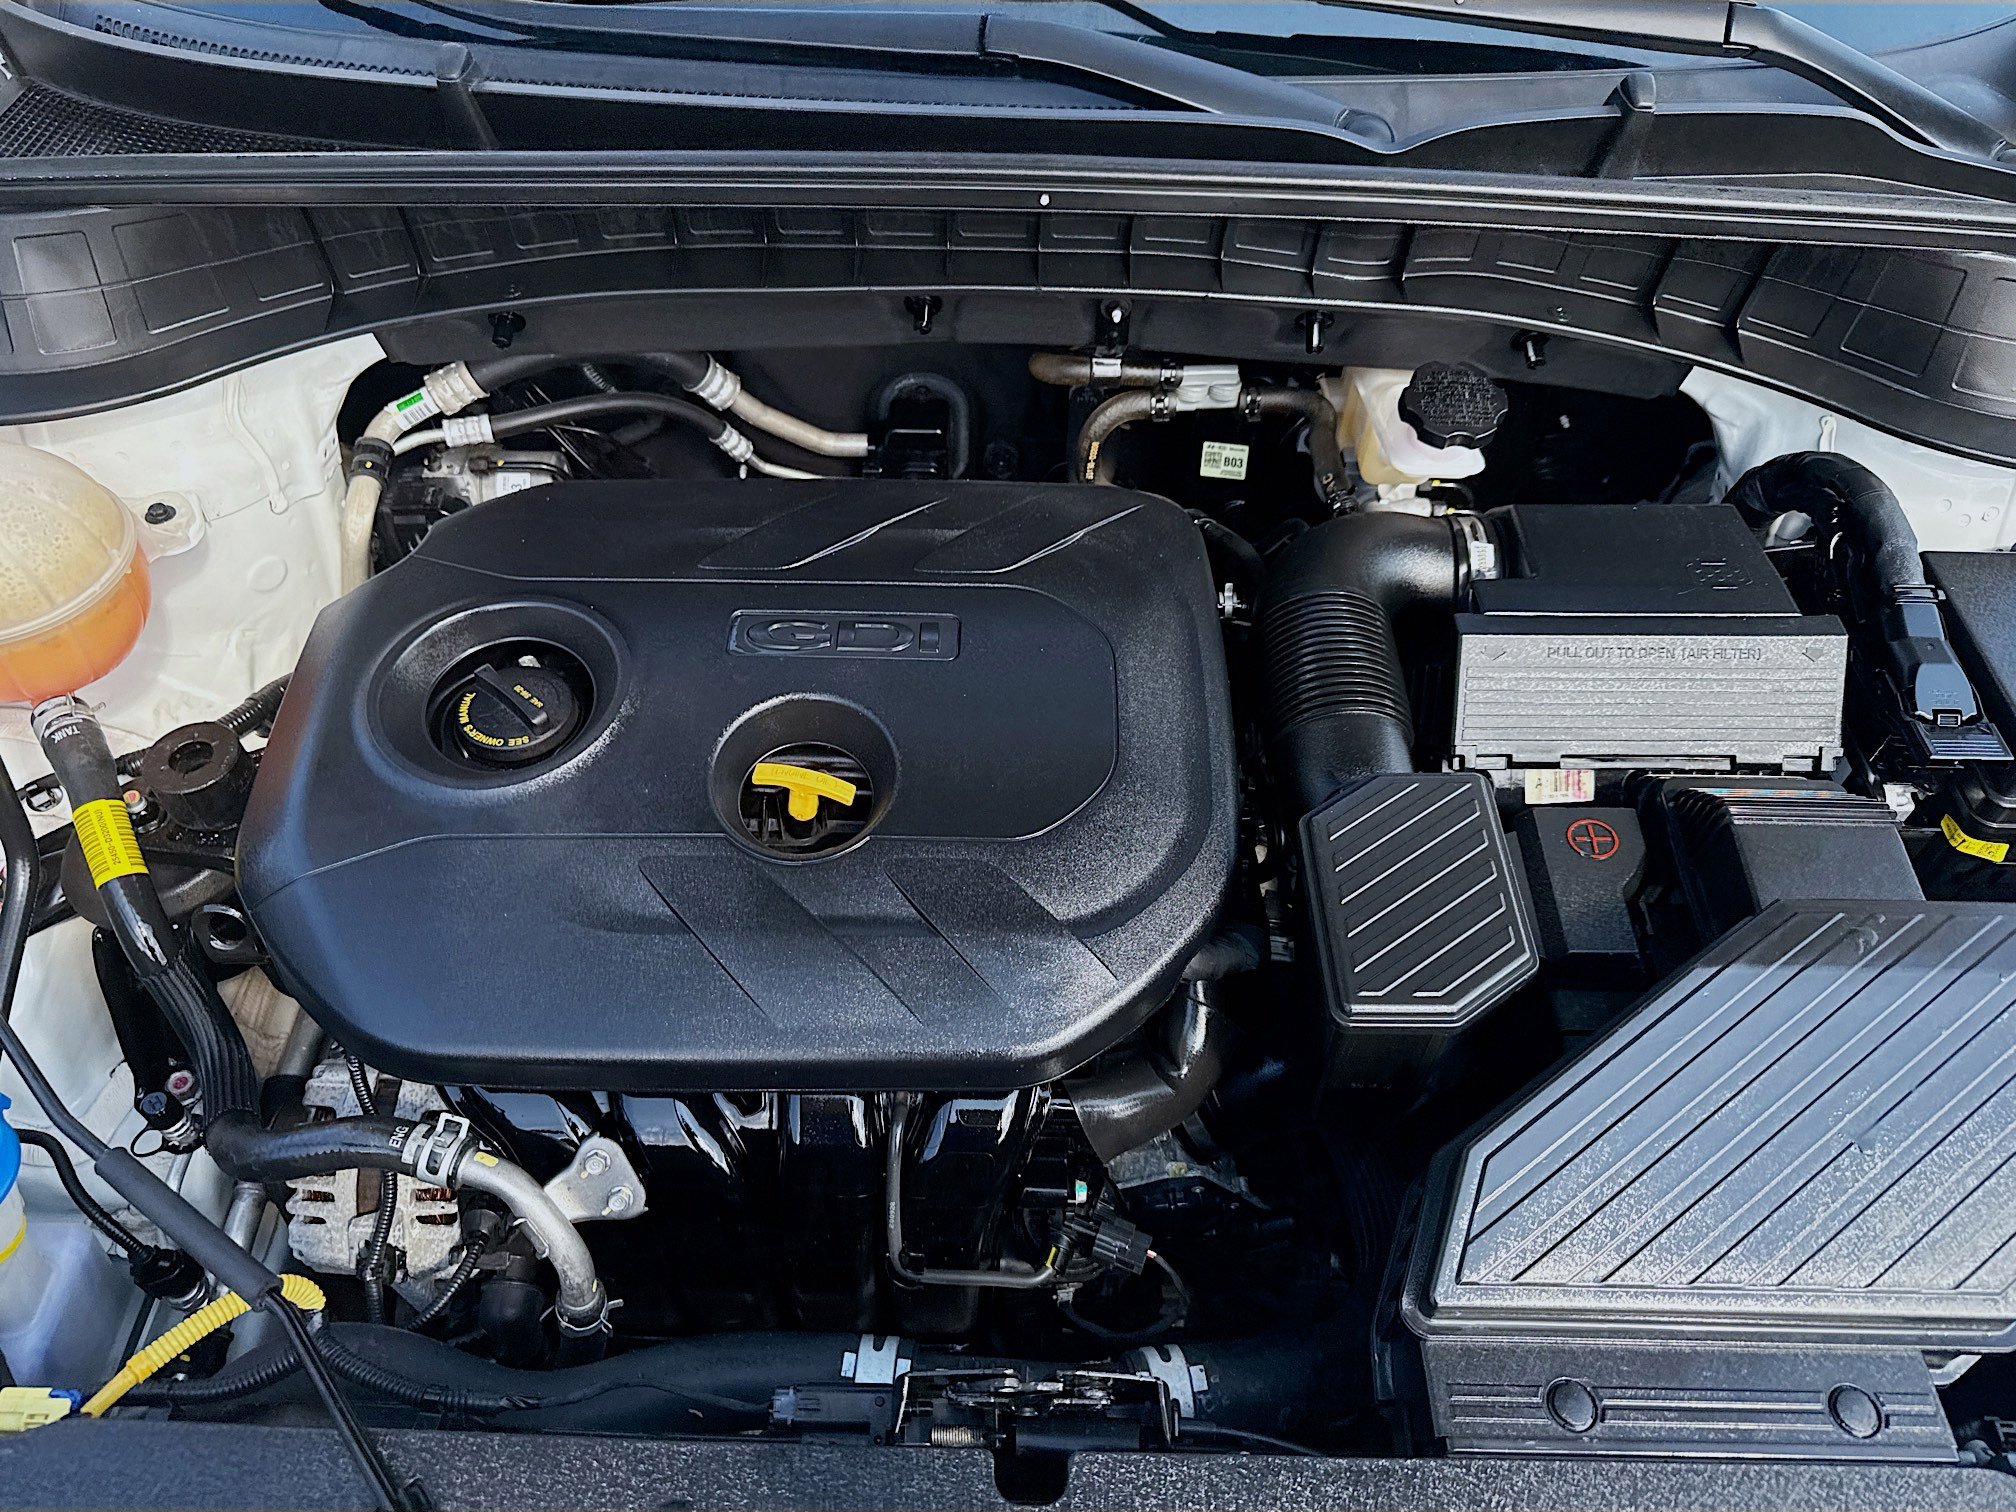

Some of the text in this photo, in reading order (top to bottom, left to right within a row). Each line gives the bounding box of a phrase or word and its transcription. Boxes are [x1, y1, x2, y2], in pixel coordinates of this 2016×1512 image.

[1223, 456, 1243, 469] B03
[745, 619, 940, 653] GDI
[1547, 646, 1582, 658] PULL
[1586, 646, 1613, 659] OUT
[1617, 646, 1633, 659] TO
[1638, 646, 1675, 659] OPEN
[458, 692, 530, 747] SEE OWNER'S MANUAL
[51, 724, 81, 744] TANK
[389, 1125, 410, 1148] ENG
